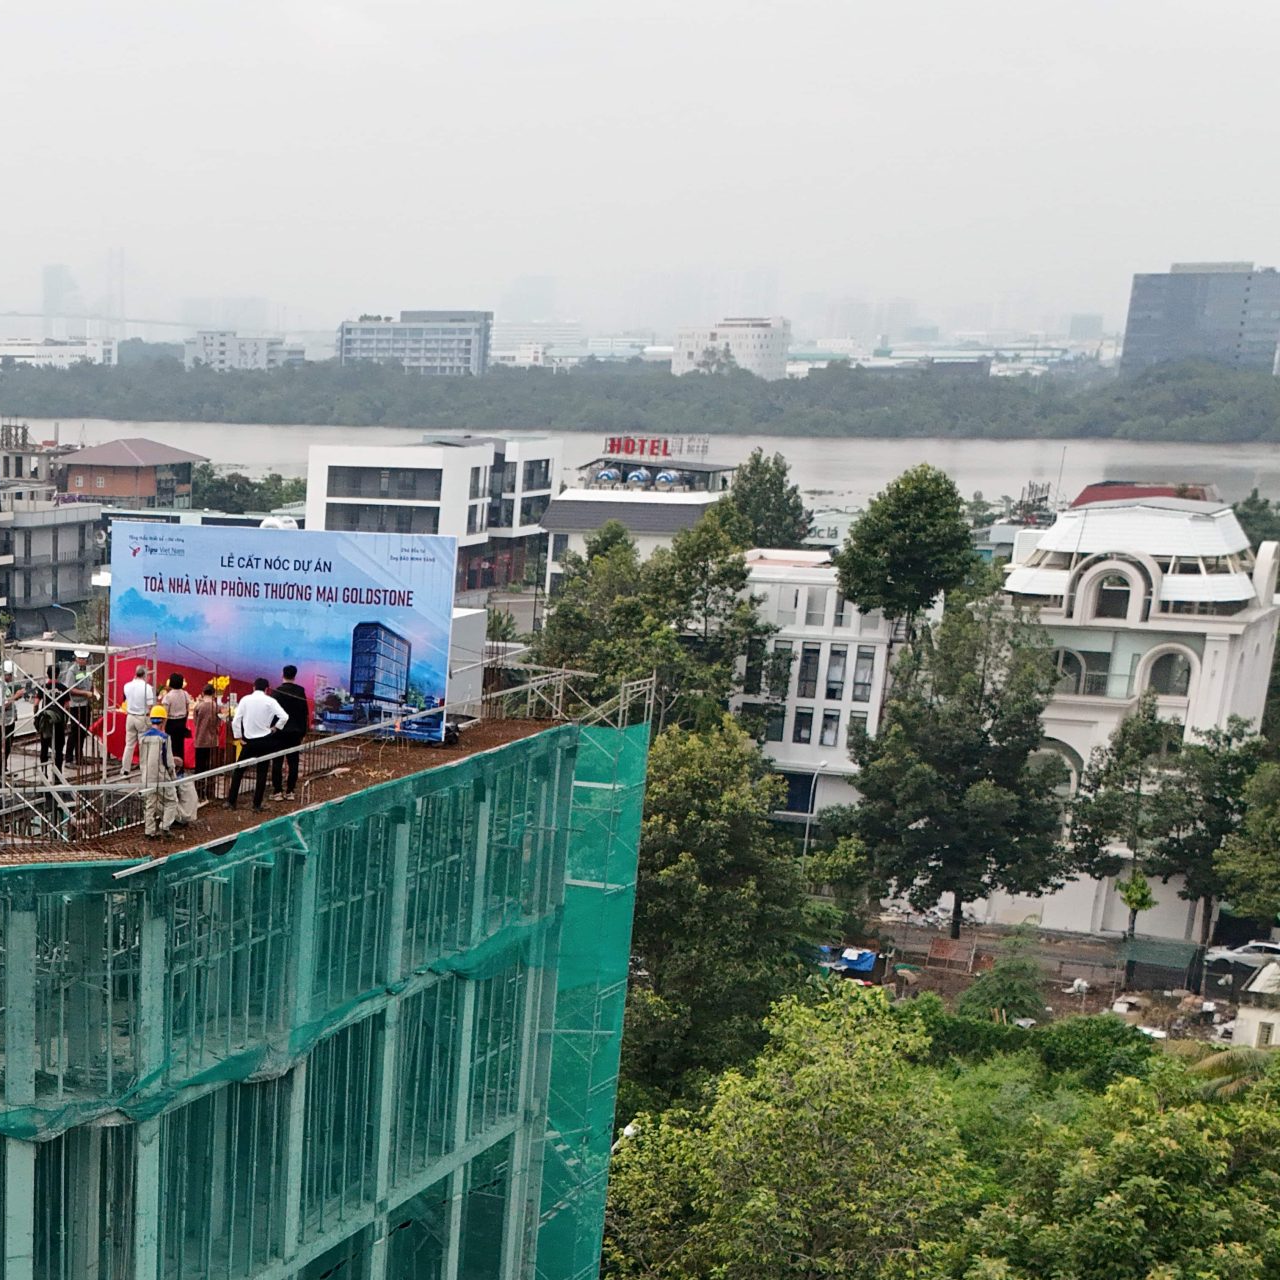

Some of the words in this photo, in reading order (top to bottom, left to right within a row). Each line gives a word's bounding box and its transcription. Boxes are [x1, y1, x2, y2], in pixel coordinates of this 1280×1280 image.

[609, 437, 672, 456] HOTEL
[238, 554, 261, 569] CẤT
[265, 556, 290, 571] NÓC
[294, 560, 312, 573] DỰ
[314, 558, 332, 573] ÁN
[144, 572, 164, 593] TOÀ
[169, 574, 191, 594] NHÀ
[195, 575, 217, 596] VĂN
[221, 577, 259, 598] PHÒNG
[264, 582, 312, 601] THƯƠNG
[316, 586, 338, 607] MẠI
[342, 587, 414, 607] GOLDSTONE
